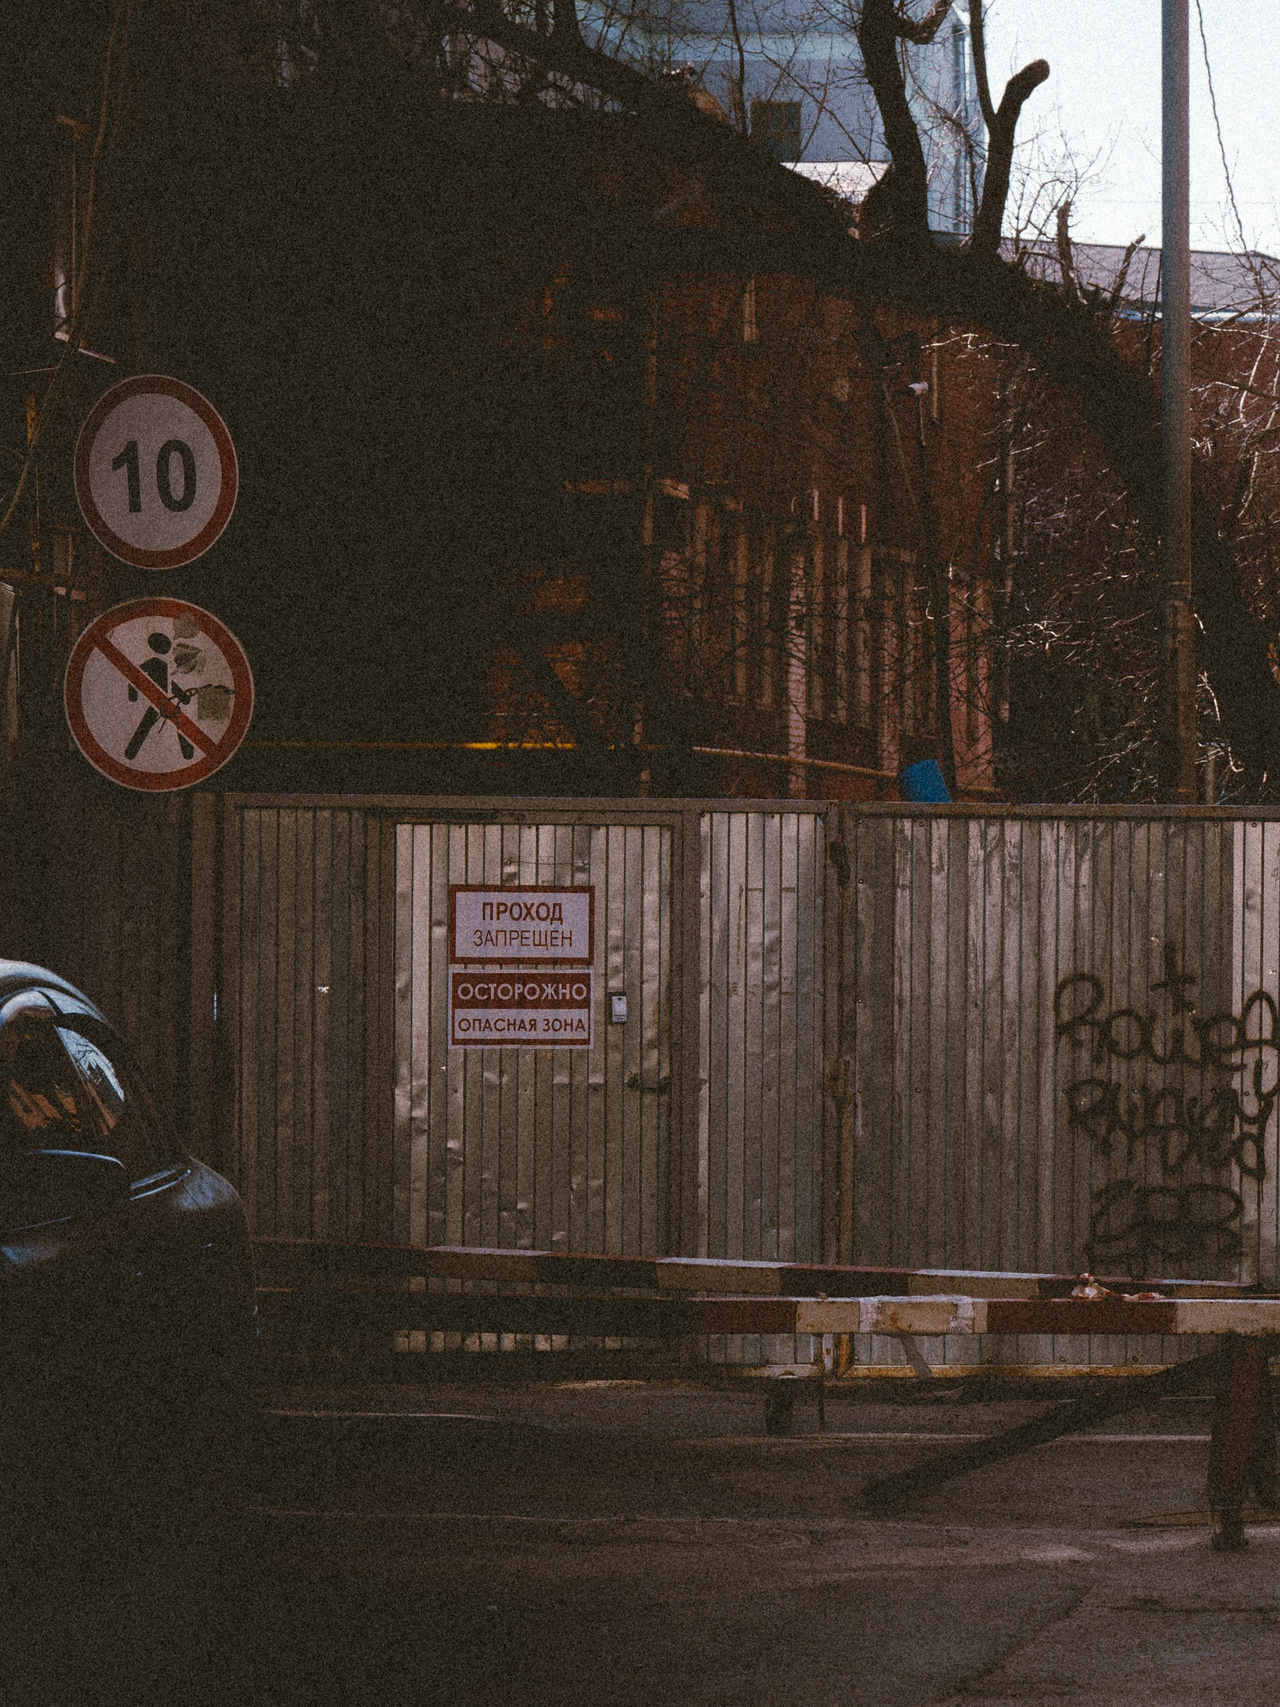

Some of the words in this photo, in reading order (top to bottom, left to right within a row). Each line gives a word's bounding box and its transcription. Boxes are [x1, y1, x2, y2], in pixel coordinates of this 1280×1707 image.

[112, 440, 197, 513] 10
[482, 902, 563, 925] ПРОХОД
[473, 929, 573, 951] ЗАПРЕЩЕН
[457, 983, 587, 1000] ОСТОРОЖНО
[458, 1018, 537, 1032] ОПАСНАЯ
[542, 1018, 586, 1032] ЗОНА
